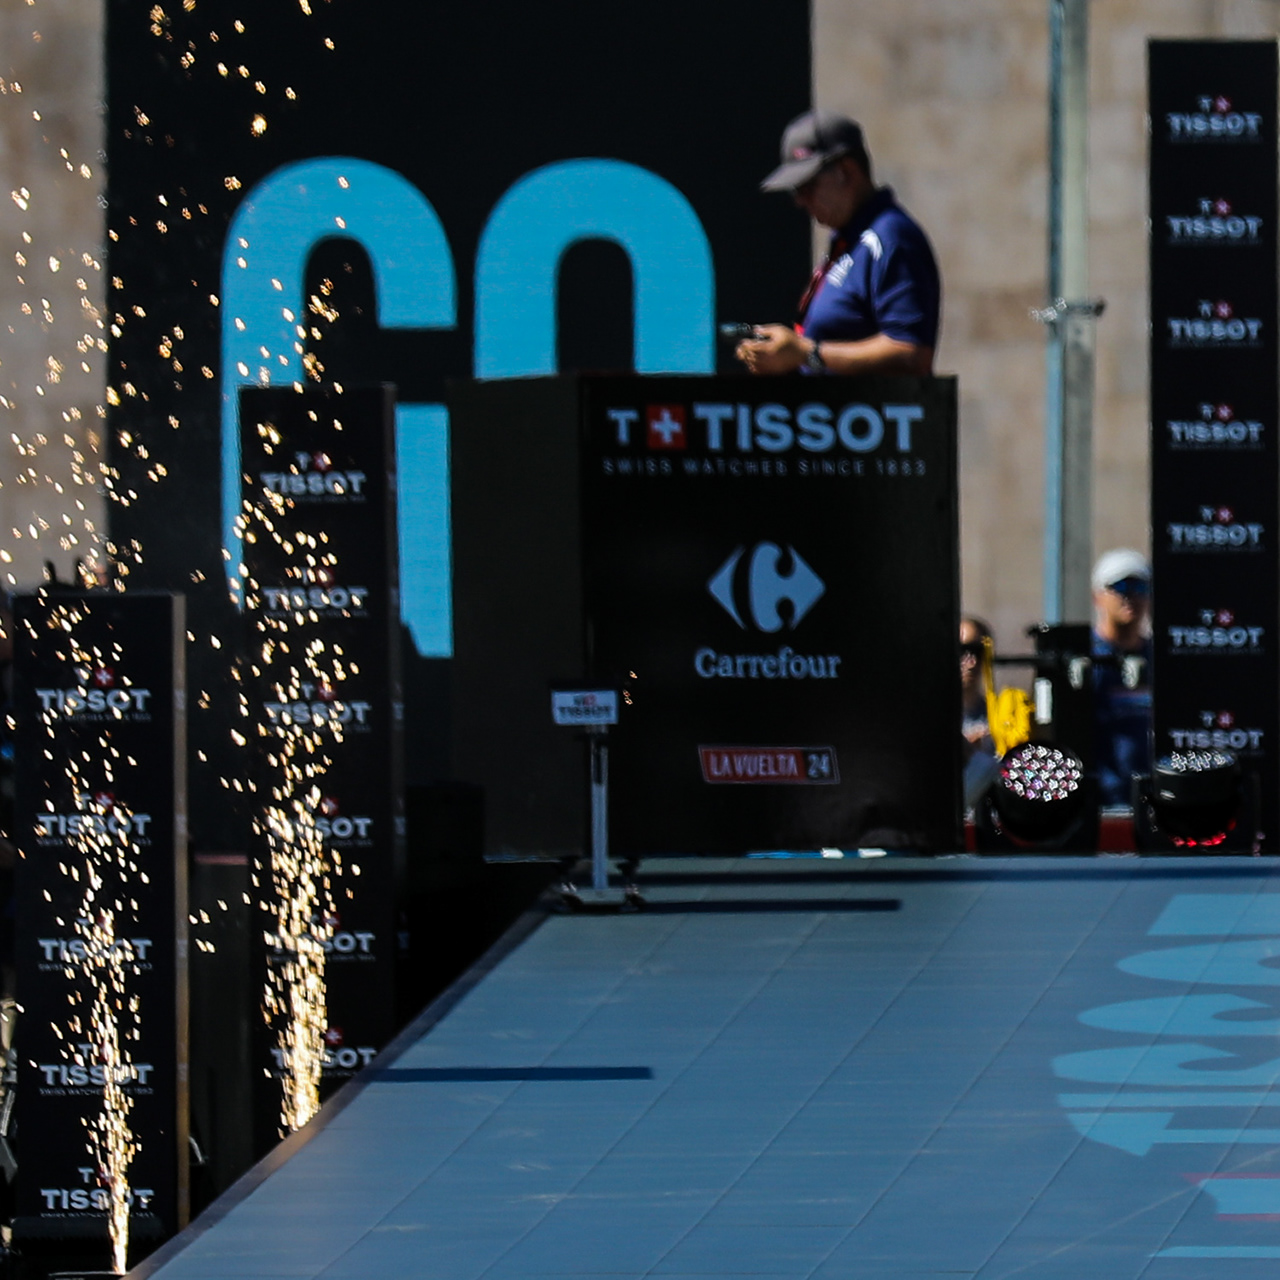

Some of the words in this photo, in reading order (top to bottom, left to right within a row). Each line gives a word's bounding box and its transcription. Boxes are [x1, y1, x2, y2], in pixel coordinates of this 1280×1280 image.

[694, 404, 924, 452] TISSOT
[602, 457, 674, 477] SWISS
[683, 457, 788, 477] WATCHES
[798, 457, 865, 477] SINCE
[694, 646, 842, 679] Carrefour
[710, 753, 732, 777] LA
[733, 753, 799, 777] VUELTA
[808, 752, 830, 778] 24
